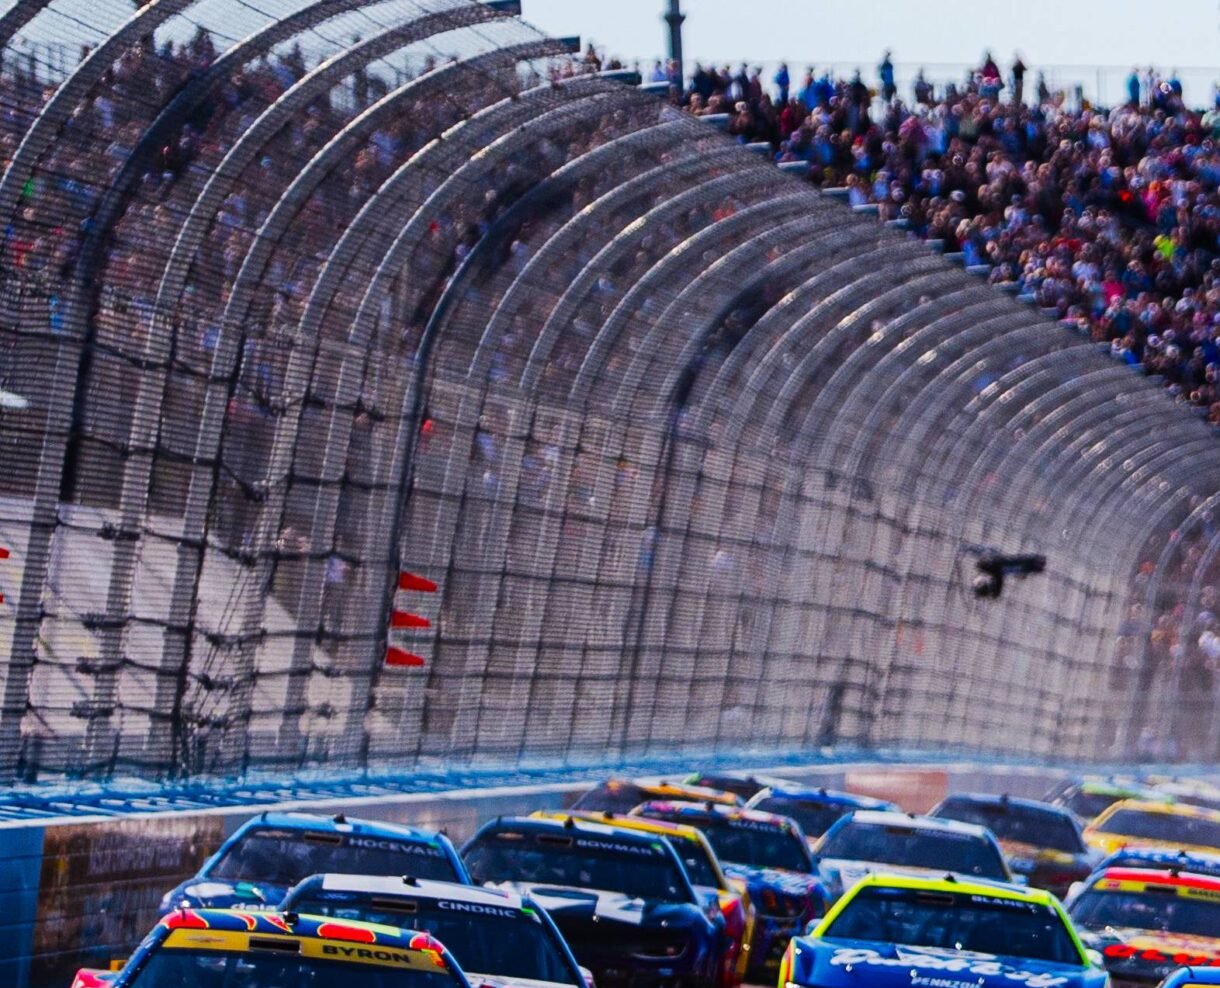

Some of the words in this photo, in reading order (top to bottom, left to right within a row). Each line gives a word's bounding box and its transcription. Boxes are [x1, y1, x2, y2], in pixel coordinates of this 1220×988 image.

[437, 900, 517, 918] CINDRIC
[971, 894, 1035, 909] BLANEY
[322, 944, 412, 964] BYRON
